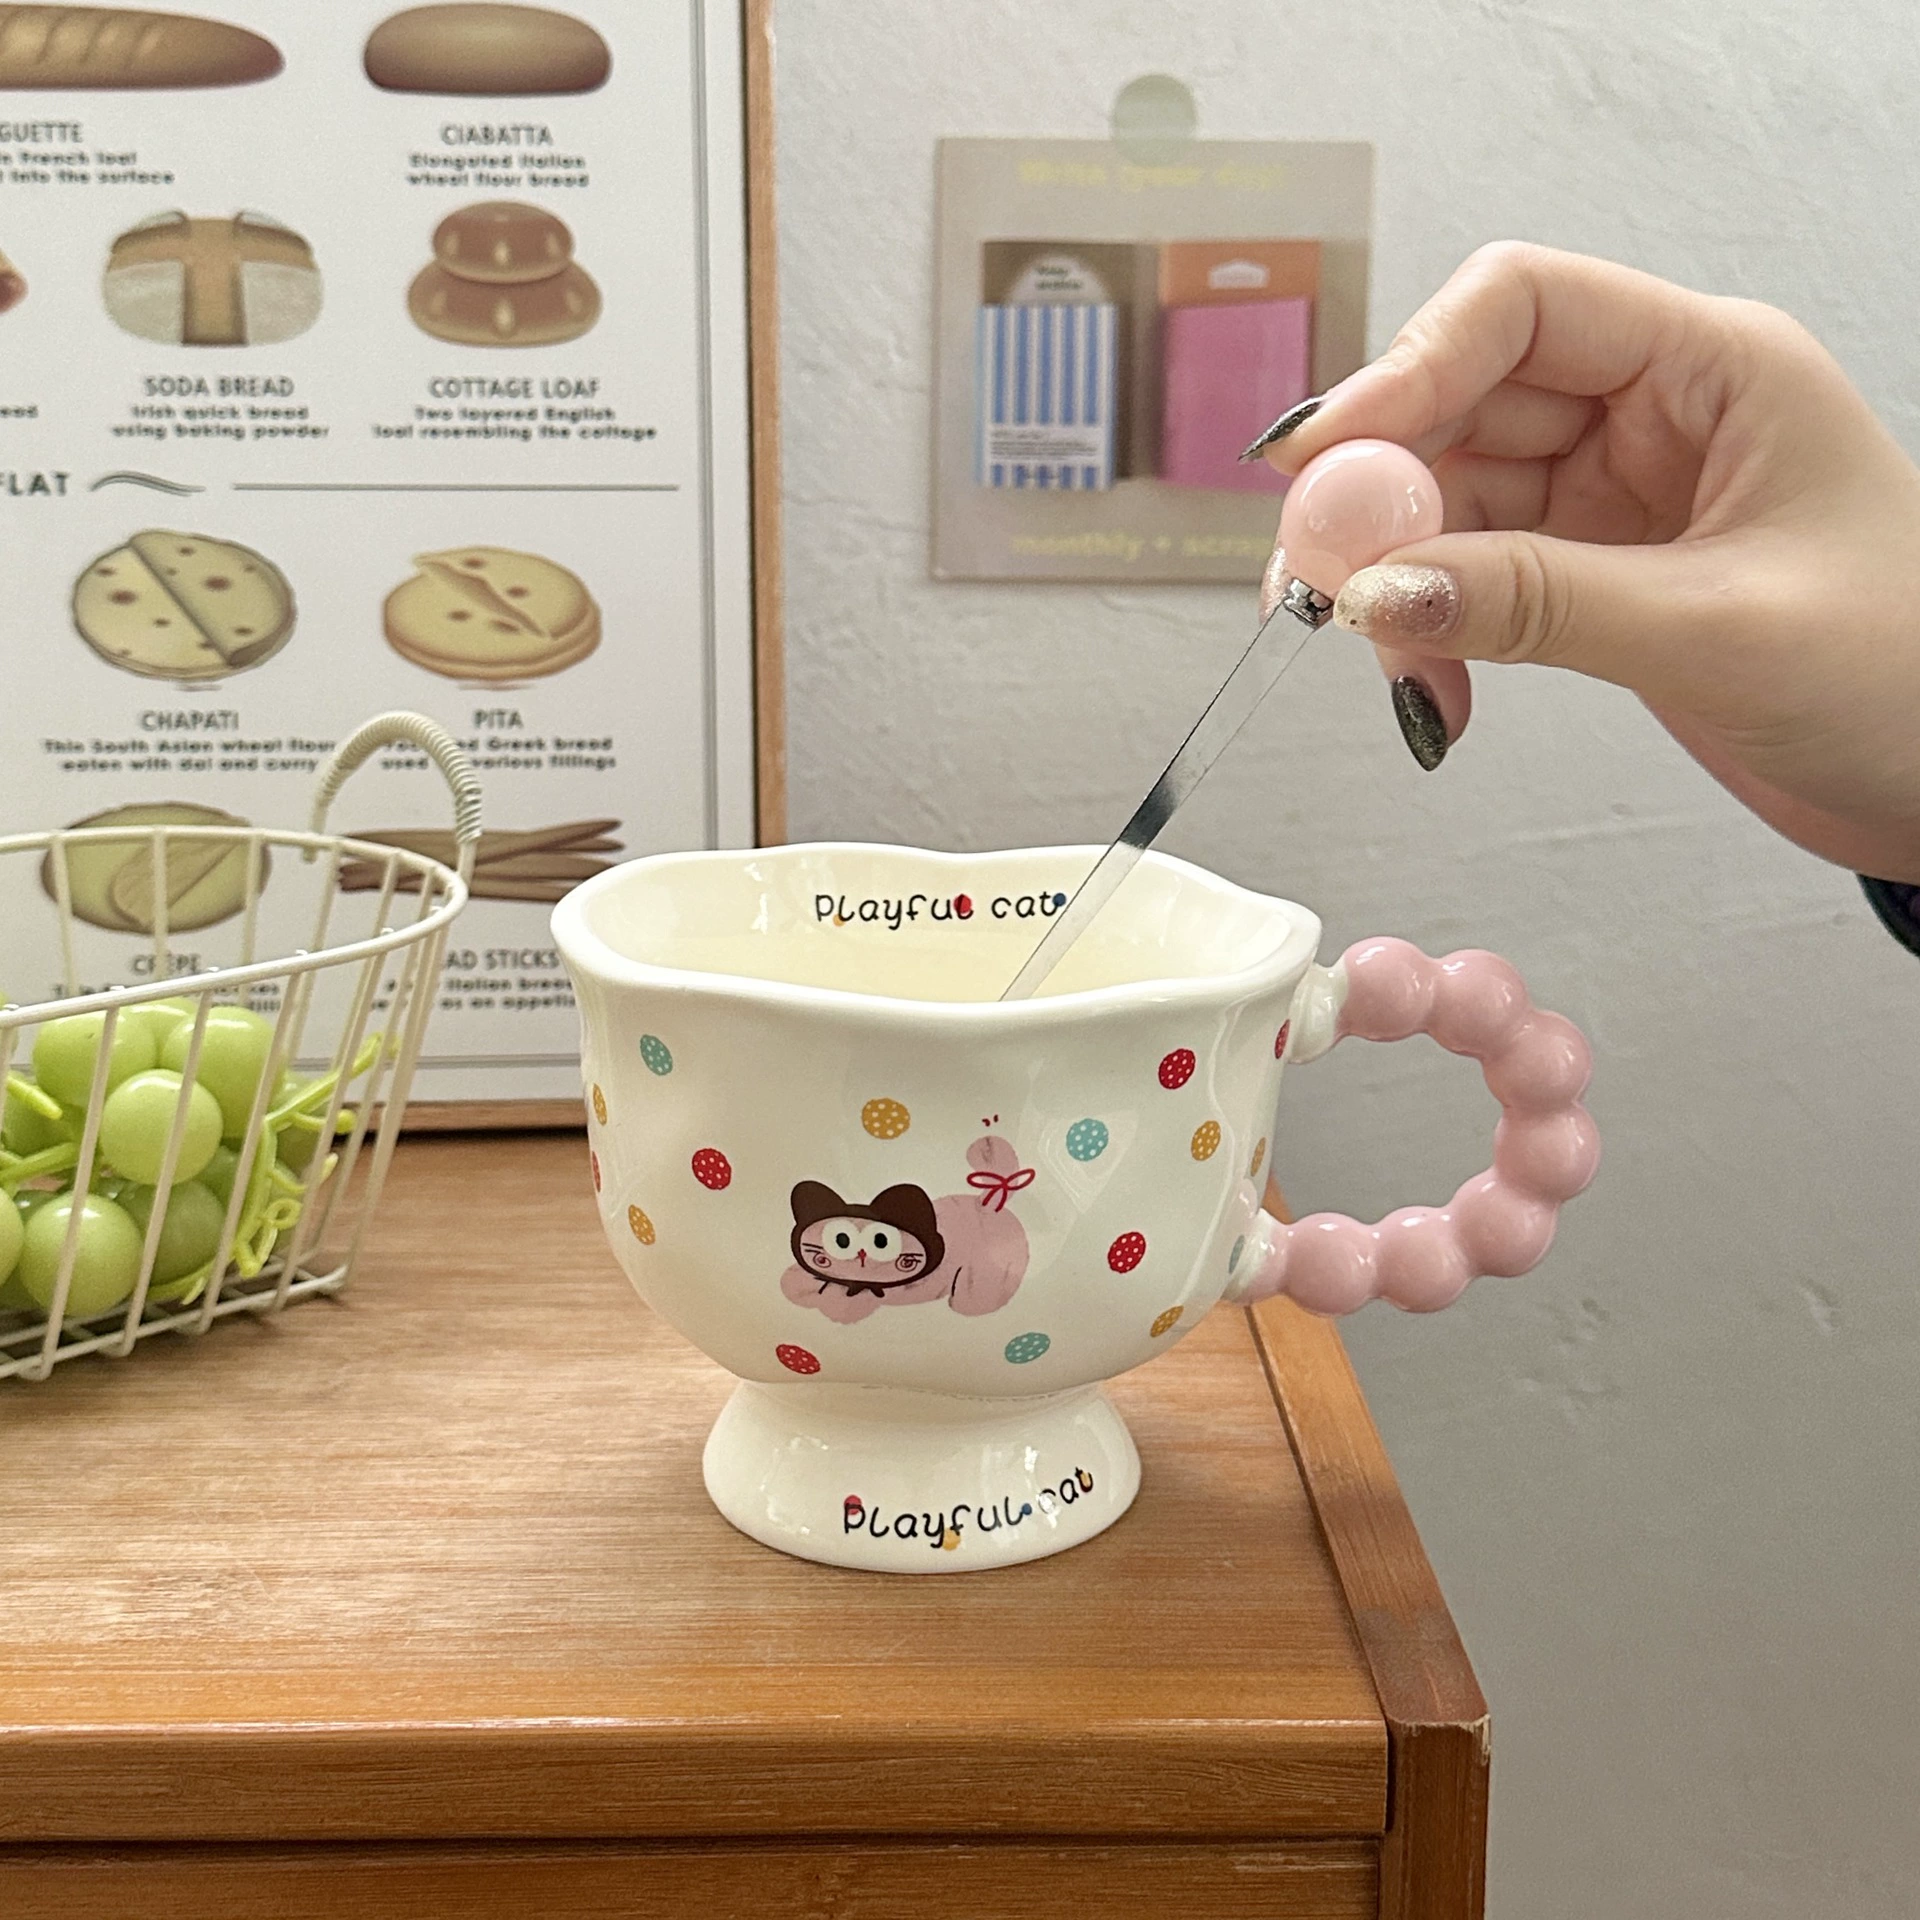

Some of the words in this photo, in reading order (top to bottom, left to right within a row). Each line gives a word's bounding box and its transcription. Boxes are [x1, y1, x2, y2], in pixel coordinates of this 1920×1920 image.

[440, 123, 554, 146] CIABATTA
[144, 375, 210, 398] SODA
[218, 375, 295, 398] BREAD
[428, 375, 534, 399] COTTAGE
[540, 375, 602, 399] LOAF
[139, 709, 240, 732] CHAPATI
[472, 707, 525, 729] PITA
[991, 890, 1062, 919] cat
[483, 948, 560, 970] STICKS
